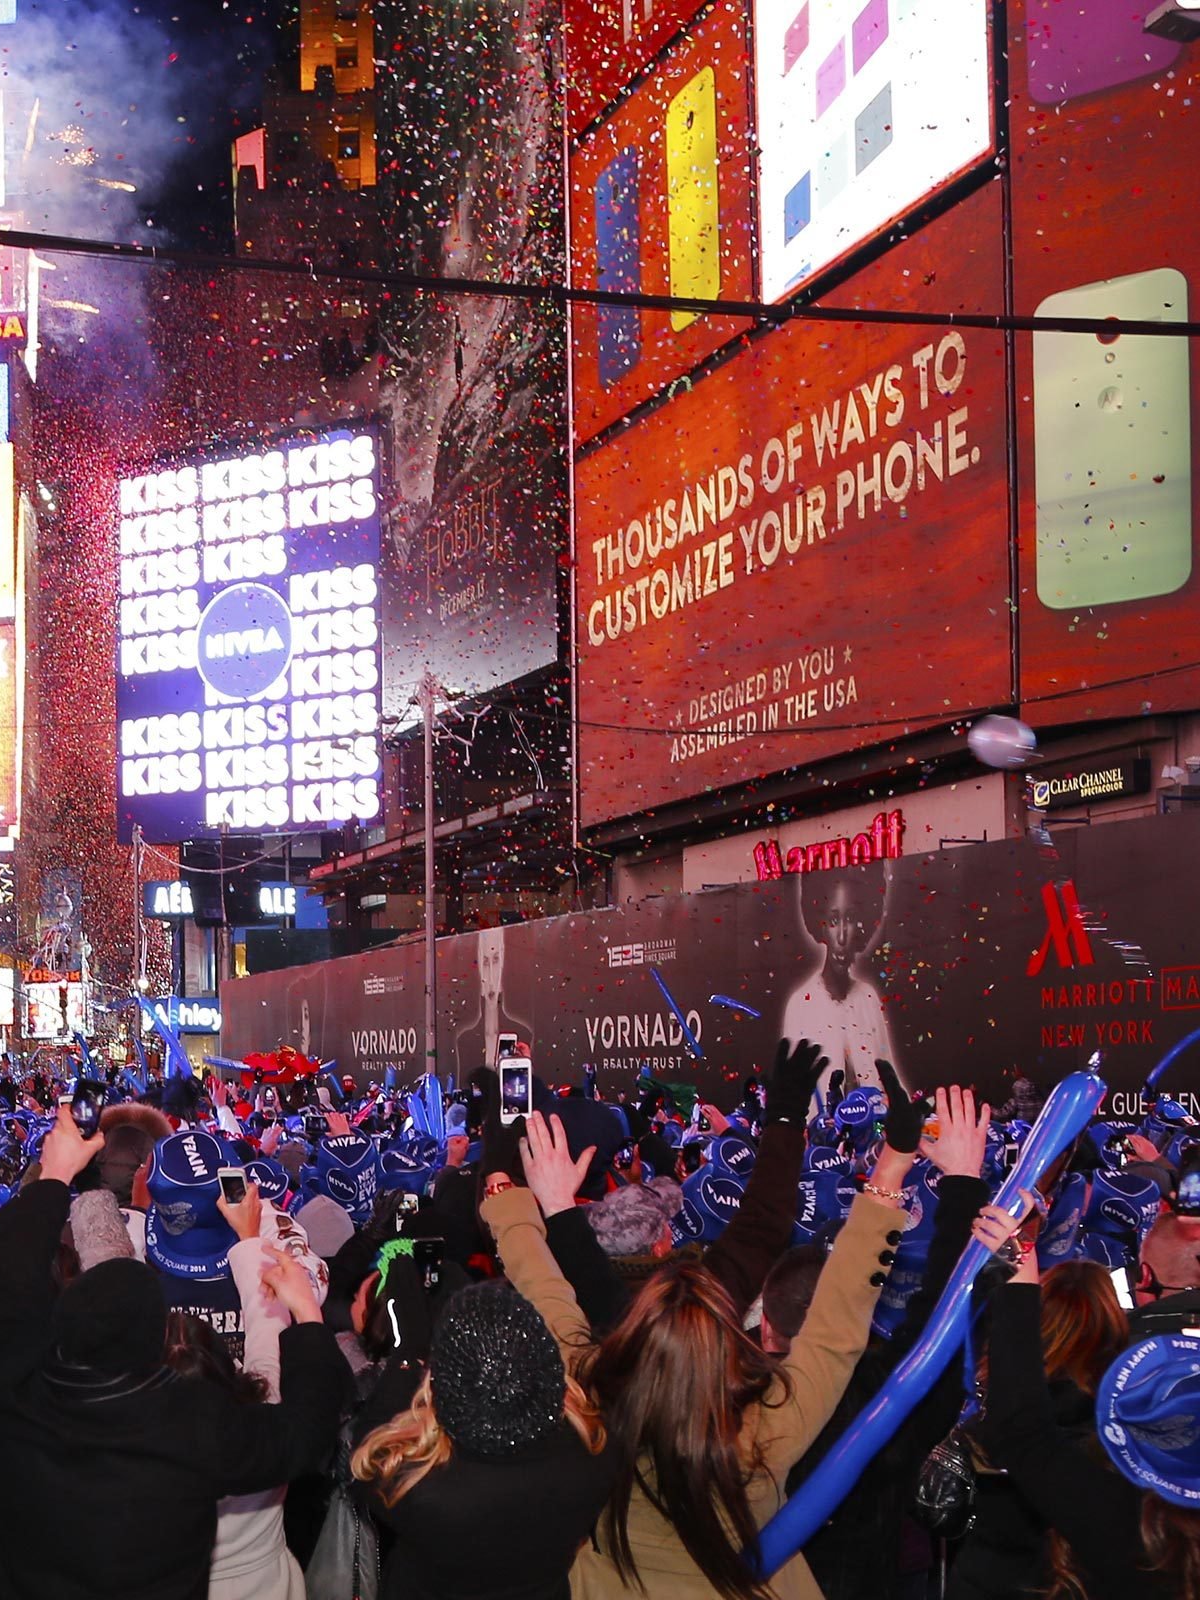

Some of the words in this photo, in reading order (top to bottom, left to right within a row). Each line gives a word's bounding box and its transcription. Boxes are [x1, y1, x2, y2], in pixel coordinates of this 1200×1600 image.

[592, 453, 754, 585] THOUSANDS
[761, 422, 803, 494] OF
[810, 364, 904, 467] WAYS
[912, 331, 966, 410] TO
[120, 467, 199, 514] KISS
[201, 451, 286, 502] KISS
[288, 436, 375, 486] KISS
[120, 508, 199, 555] KISS
[203, 493, 286, 541] KISS
[288, 478, 376, 529] KISS
[587, 531, 734, 647] CUSTOMIZE
[740, 485, 827, 576] YOUR
[836, 406, 981, 530] PHONE.
[121, 548, 199, 594] KISS
[203, 535, 287, 583] KISS
[121, 590, 200, 635] KISS
[290, 564, 378, 613] KISS
[121, 630, 199, 676] KISS
[291, 607, 378, 654] KISS
[206, 626, 284, 659] NIVEA
[291, 650, 378, 697] KISS
[689, 672, 767, 721] DESIGNED
[773, 662, 792, 694] BY
[799, 647, 834, 683] YOU
[122, 712, 201, 756] KISS
[203, 704, 288, 749] KISS
[291, 693, 379, 740] KISS
[669, 713, 757, 763] ASSEMBLED
[762, 704, 778, 730] IN
[784, 692, 818, 721] THE
[823, 675, 858, 711] USA
[122, 753, 201, 797] KISS
[205, 744, 289, 789] KISS
[292, 736, 379, 782] KISS
[1050, 777, 1079, 794] CLEAR
[1079, 768, 1123, 788] CHANNEL
[206, 786, 289, 828] KISS
[293, 778, 379, 823] KISS
[1081, 781, 1123, 797] SPECTACOLOR
[607, 943, 644, 968] 1535
[1041, 978, 1154, 1009] MARRIOTT
[351, 1027, 417, 1058] VORNADO
[585, 1010, 701, 1054] VORNADO
[1041, 1024, 1086, 1048] NEW
[1095, 1020, 1154, 1045] YORK
[362, 1061, 384, 1071] REALTY
[603, 1058, 640, 1069] REALTY
[840, 1106, 865, 1114] NIVEA
[182, 1135, 209, 1178] NIVEA
[328, 1136, 366, 1149] NIVEA
[357, 1163, 375, 1182] NEW
[814, 1155, 849, 1170] NIVEA
[329, 1176, 354, 1194] NIVEA
[359, 1183, 377, 1201] EVE
[1104, 1205, 1135, 1225] NIVEA
[164, 1258, 188, 1272] SQUARE
[1128, 1341, 1157, 1369] HAPPY
[1172, 1339, 1198, 1350] 2014
[1116, 1367, 1131, 1390] NEW
[1121, 1449, 1141, 1475] TIMES
[1139, 1470, 1182, 1495] SQUARE
